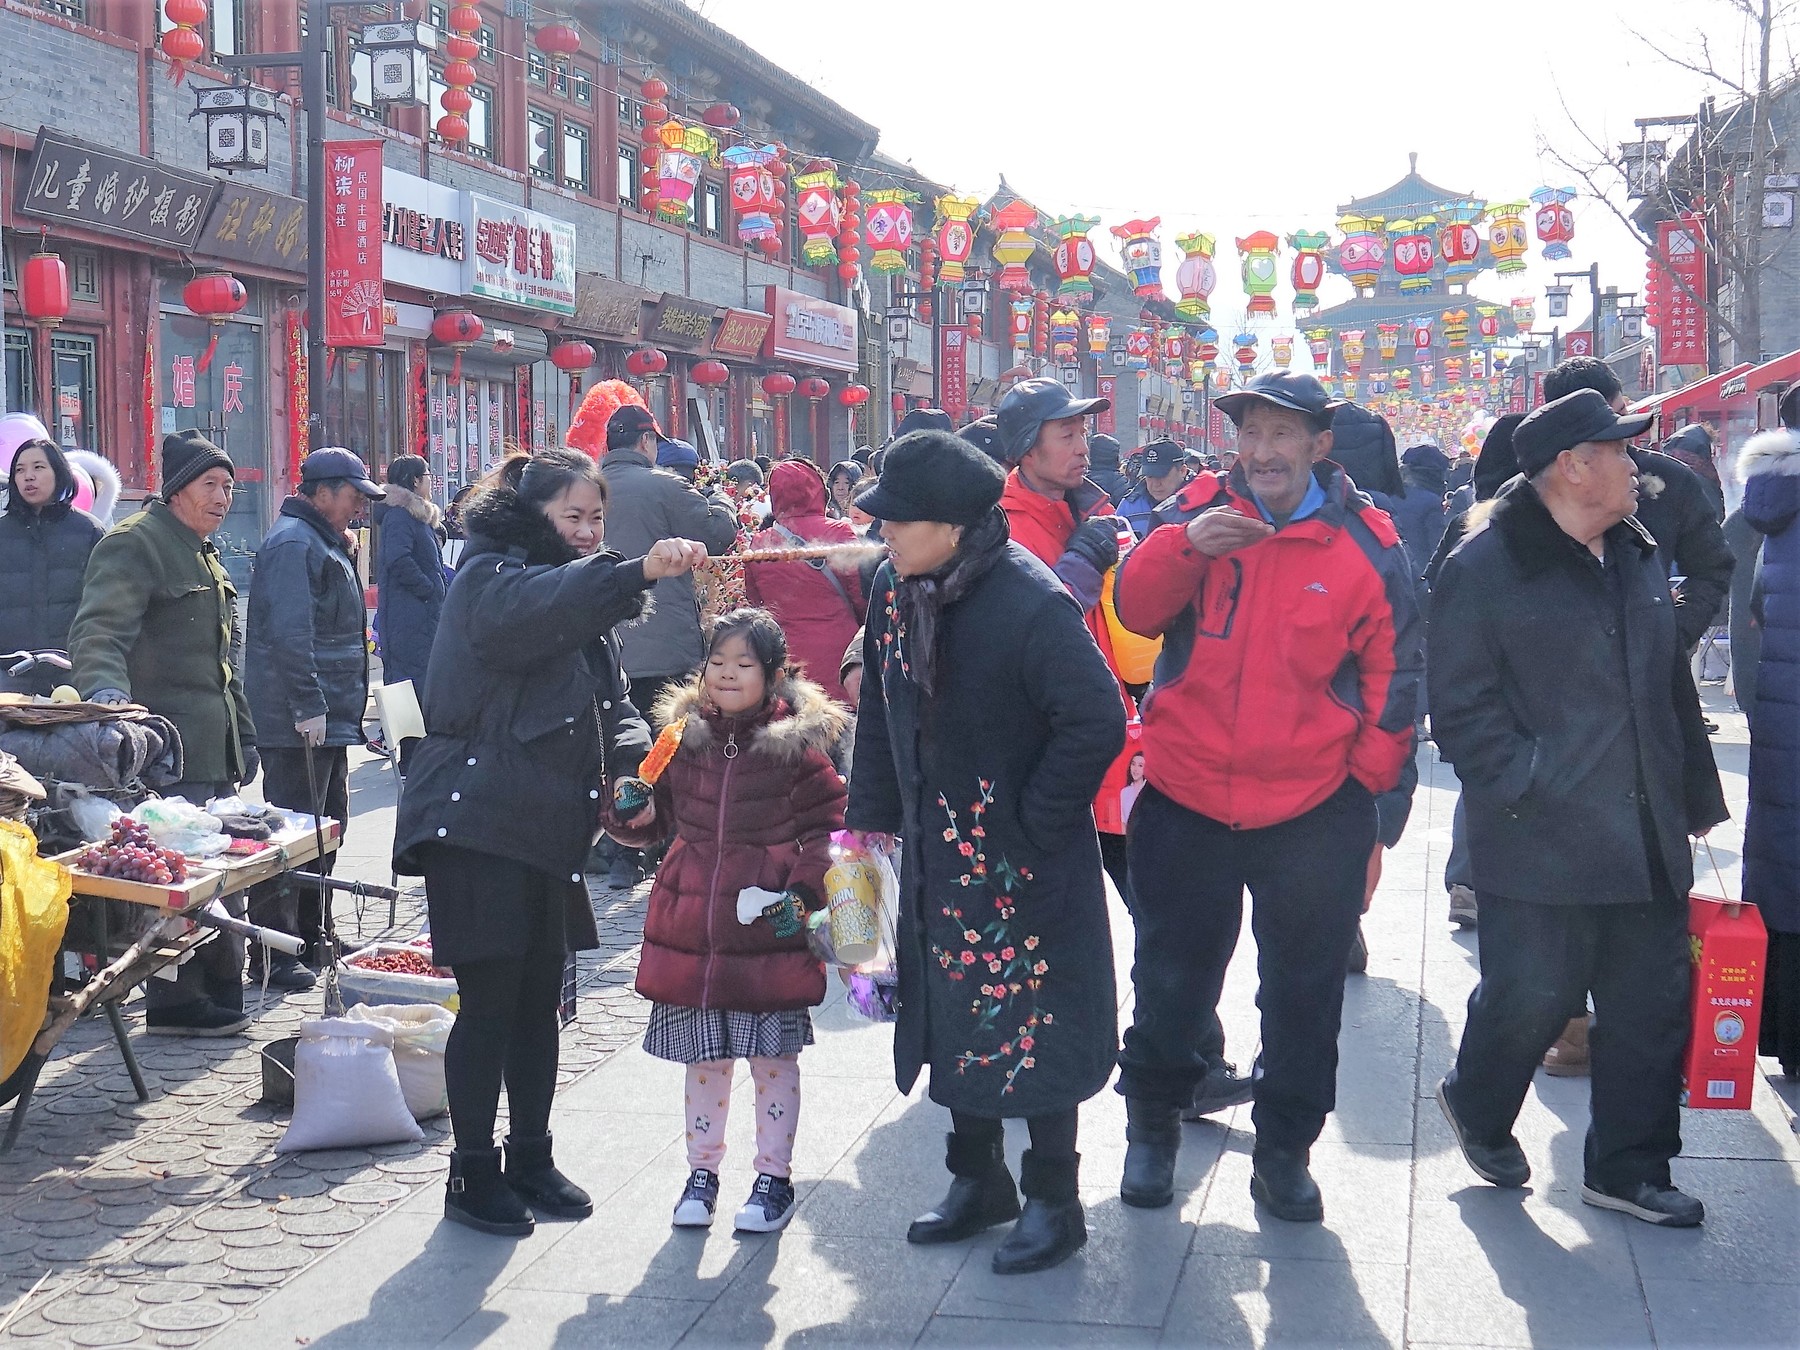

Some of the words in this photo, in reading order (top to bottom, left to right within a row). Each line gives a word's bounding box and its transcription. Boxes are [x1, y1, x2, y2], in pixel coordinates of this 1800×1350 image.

[34, 158, 201, 237] 儿童婚纱摄影
[335, 203, 347, 227] 旅社
[357, 171, 368, 265] 民国主题酒店
[381, 201, 466, 261] 力健老人鞋
[447, 391, 459, 472] 欢迎
[467, 394, 479, 471] 光临
